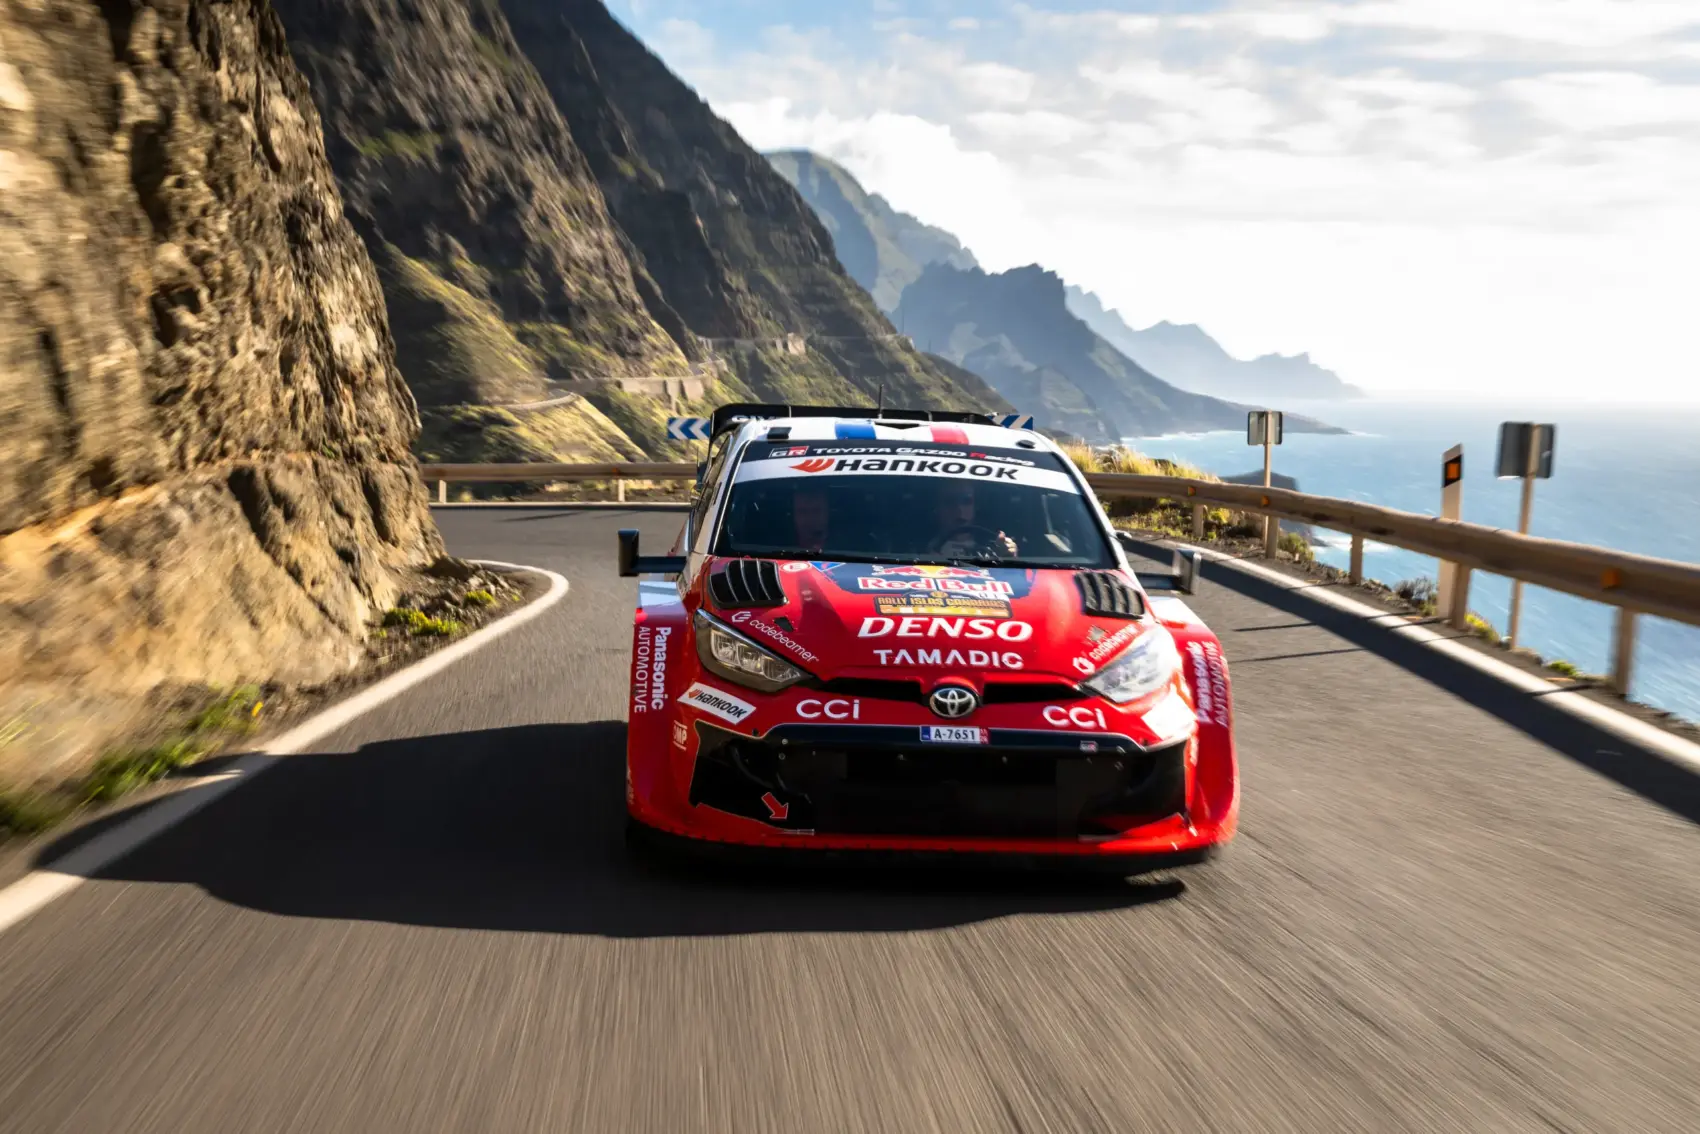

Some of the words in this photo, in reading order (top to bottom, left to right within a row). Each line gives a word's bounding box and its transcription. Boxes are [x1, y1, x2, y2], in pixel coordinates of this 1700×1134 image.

[813, 447, 891, 455] TOYOTA
[895, 447, 967, 457] GAZOO
[969, 451, 1035, 467] Racing
[858, 577, 936, 591] Red
[937, 579, 1014, 596] Bull
[878, 597, 907, 605] RALLY
[749, 619, 815, 662] codebeamer
[857, 617, 1034, 642] DENSO
[634, 626, 651, 714] AUTOMOTIVE
[651, 626, 672, 711] Panasonic
[873, 648, 1024, 670] TAMADIC
[934, 728, 975, 740] A-7651
